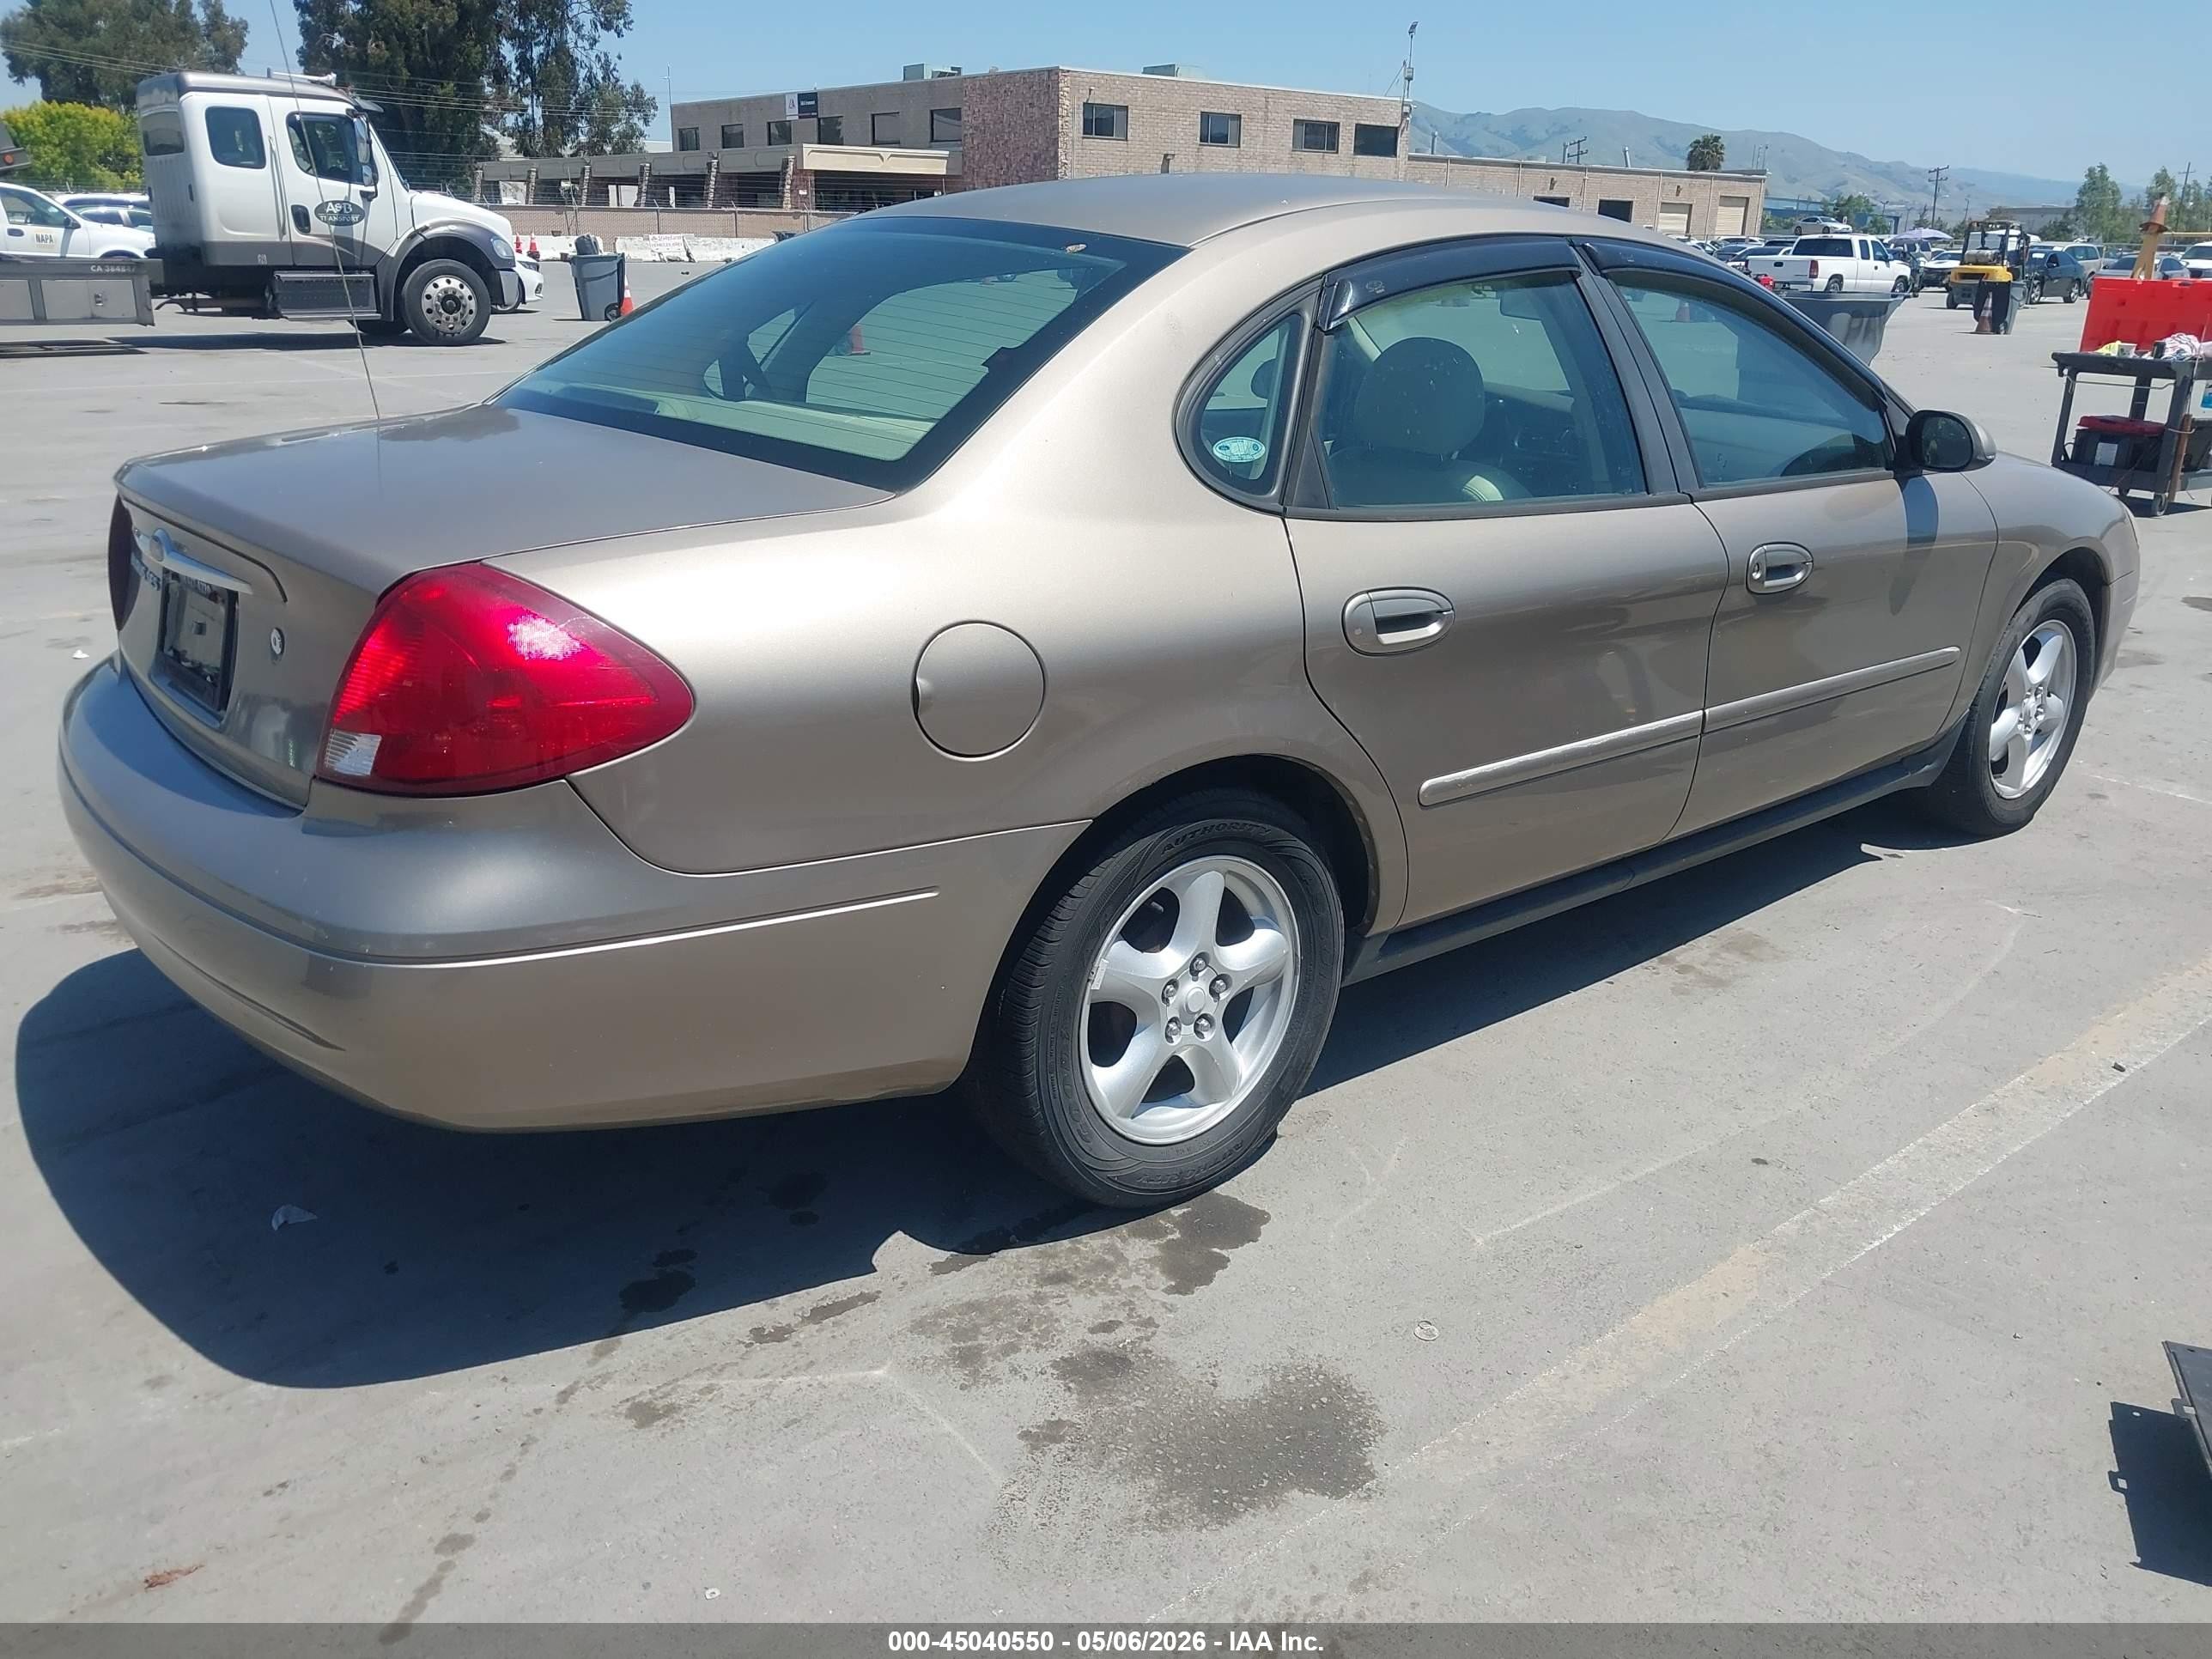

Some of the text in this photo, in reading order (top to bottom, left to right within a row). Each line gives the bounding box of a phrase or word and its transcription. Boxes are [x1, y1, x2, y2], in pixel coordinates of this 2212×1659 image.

[325, 202, 353, 214] A&B
[35, 233, 54, 244] NAPA
[90, 264, 103, 273] CA
[1160, 821, 1273, 855] AUTHORITY
